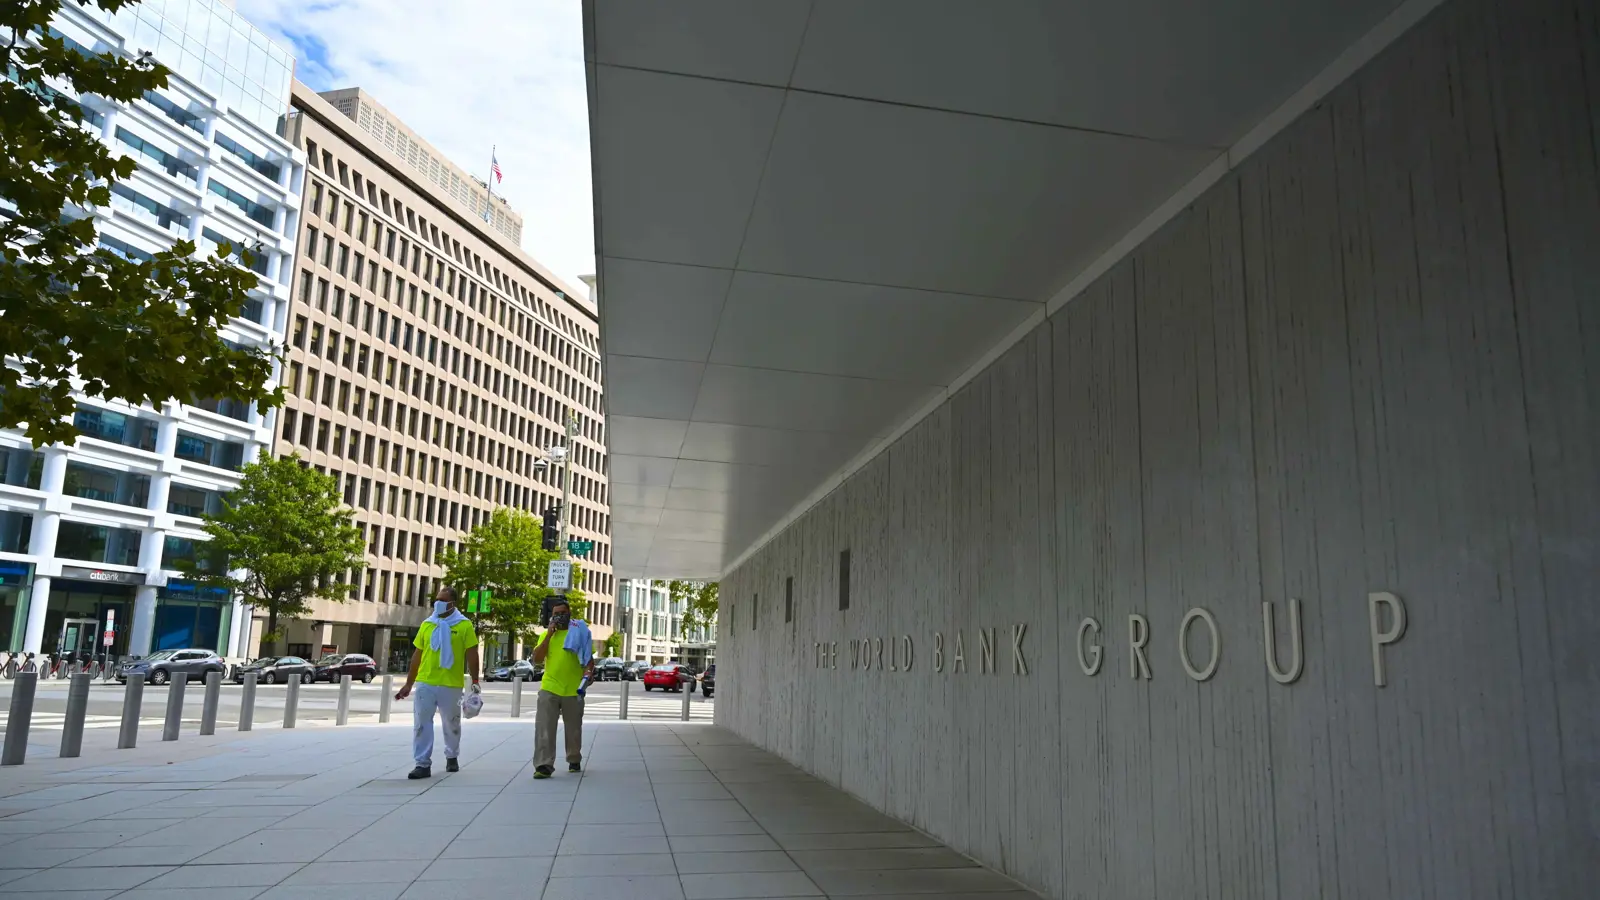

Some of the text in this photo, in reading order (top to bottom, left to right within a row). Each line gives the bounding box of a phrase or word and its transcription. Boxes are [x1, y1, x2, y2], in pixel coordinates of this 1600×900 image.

[90, 570, 119, 581] citibank
[814, 591, 1408, 688] THE WORLD BANK GROUP
